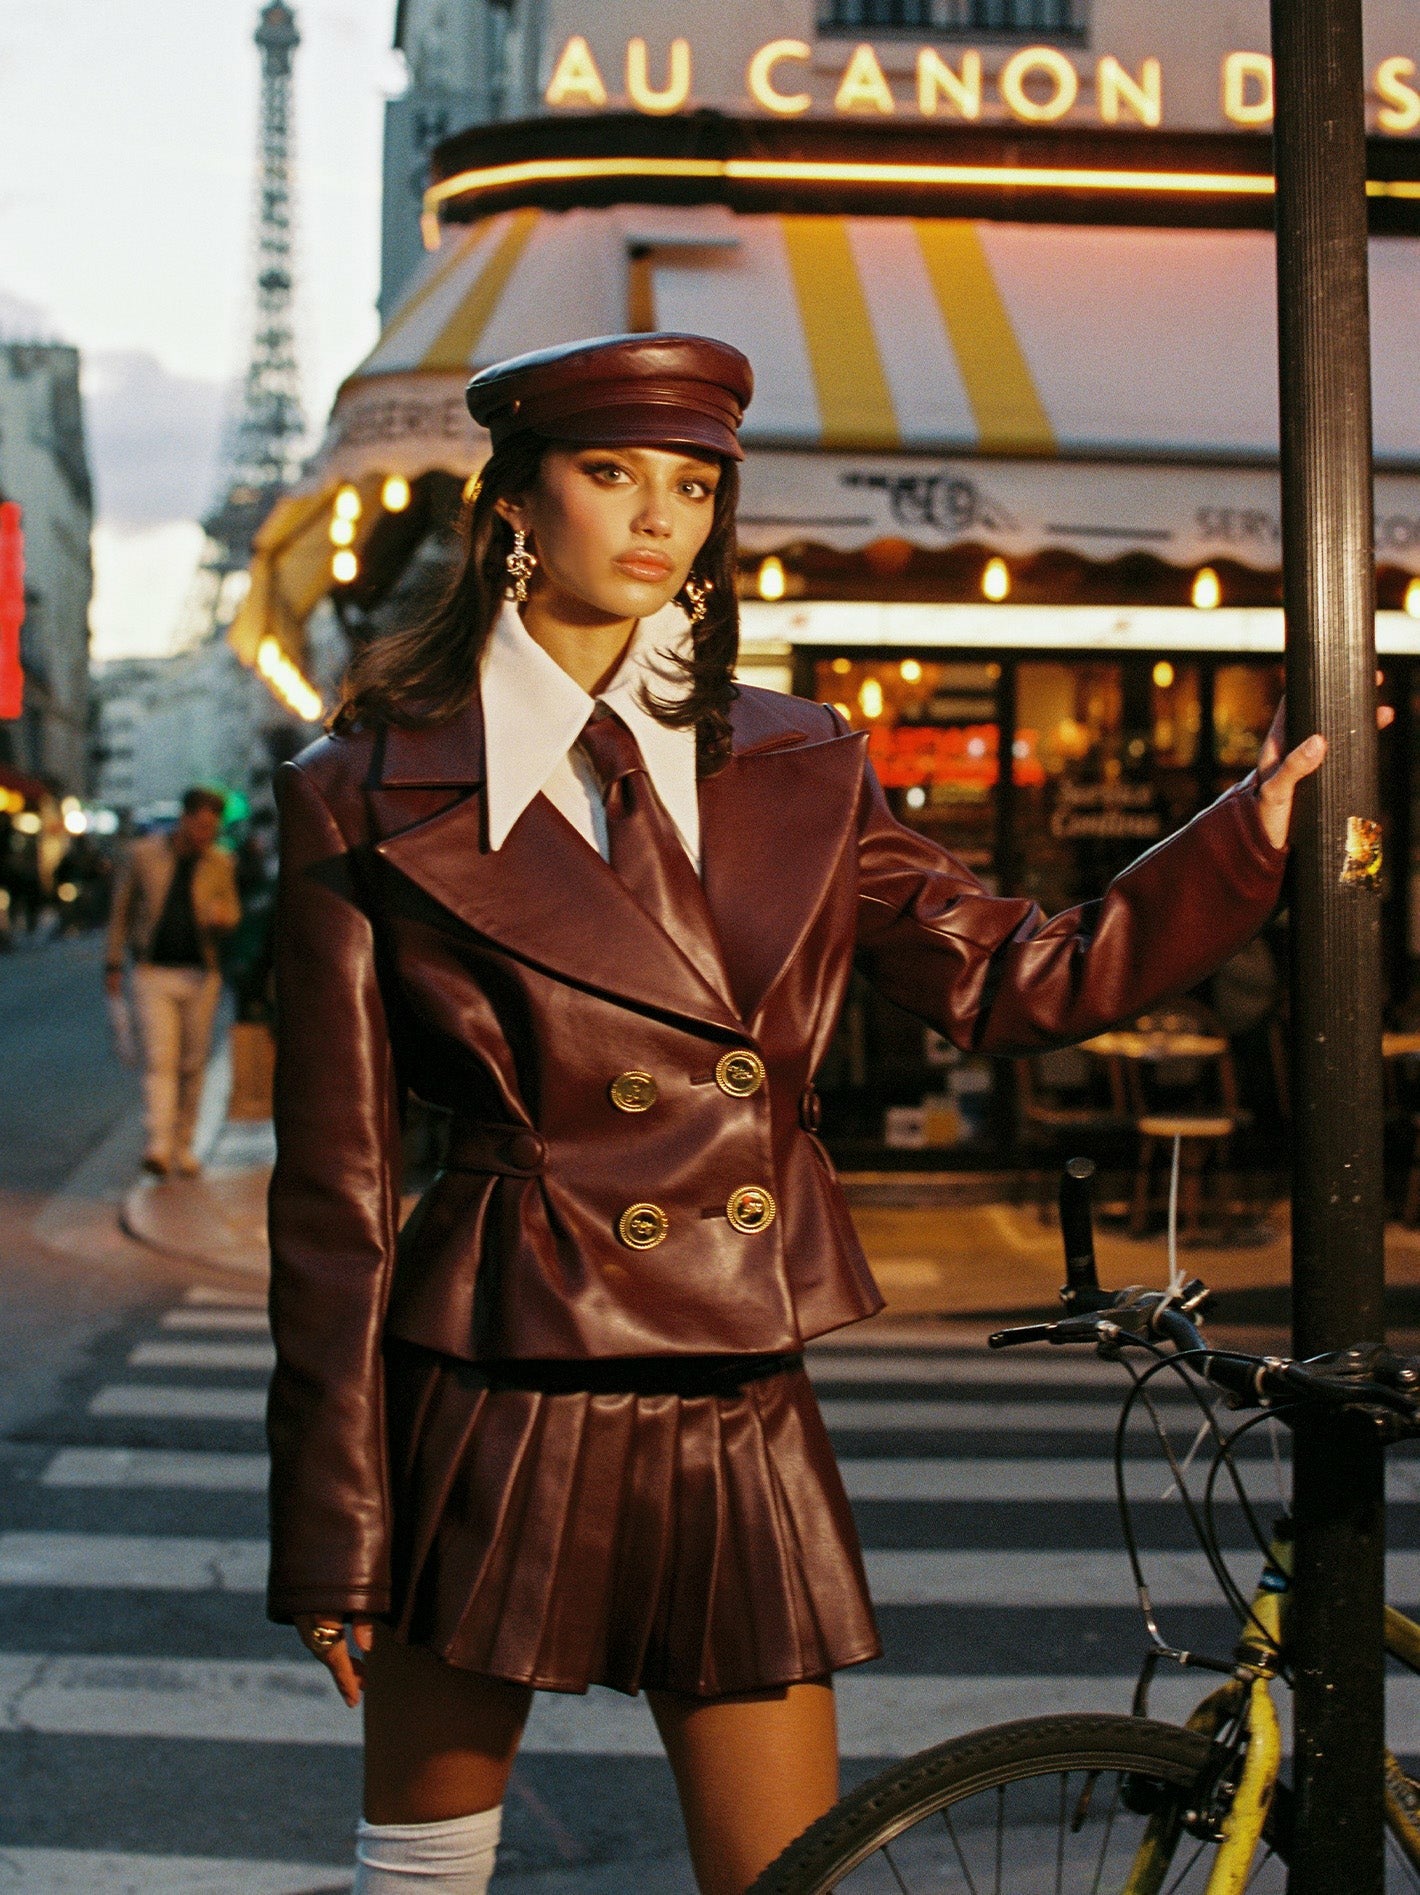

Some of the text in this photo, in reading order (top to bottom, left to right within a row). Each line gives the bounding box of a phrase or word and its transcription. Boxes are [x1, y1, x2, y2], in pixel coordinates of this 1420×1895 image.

[546, 35, 1420, 132] AU CANON DS
